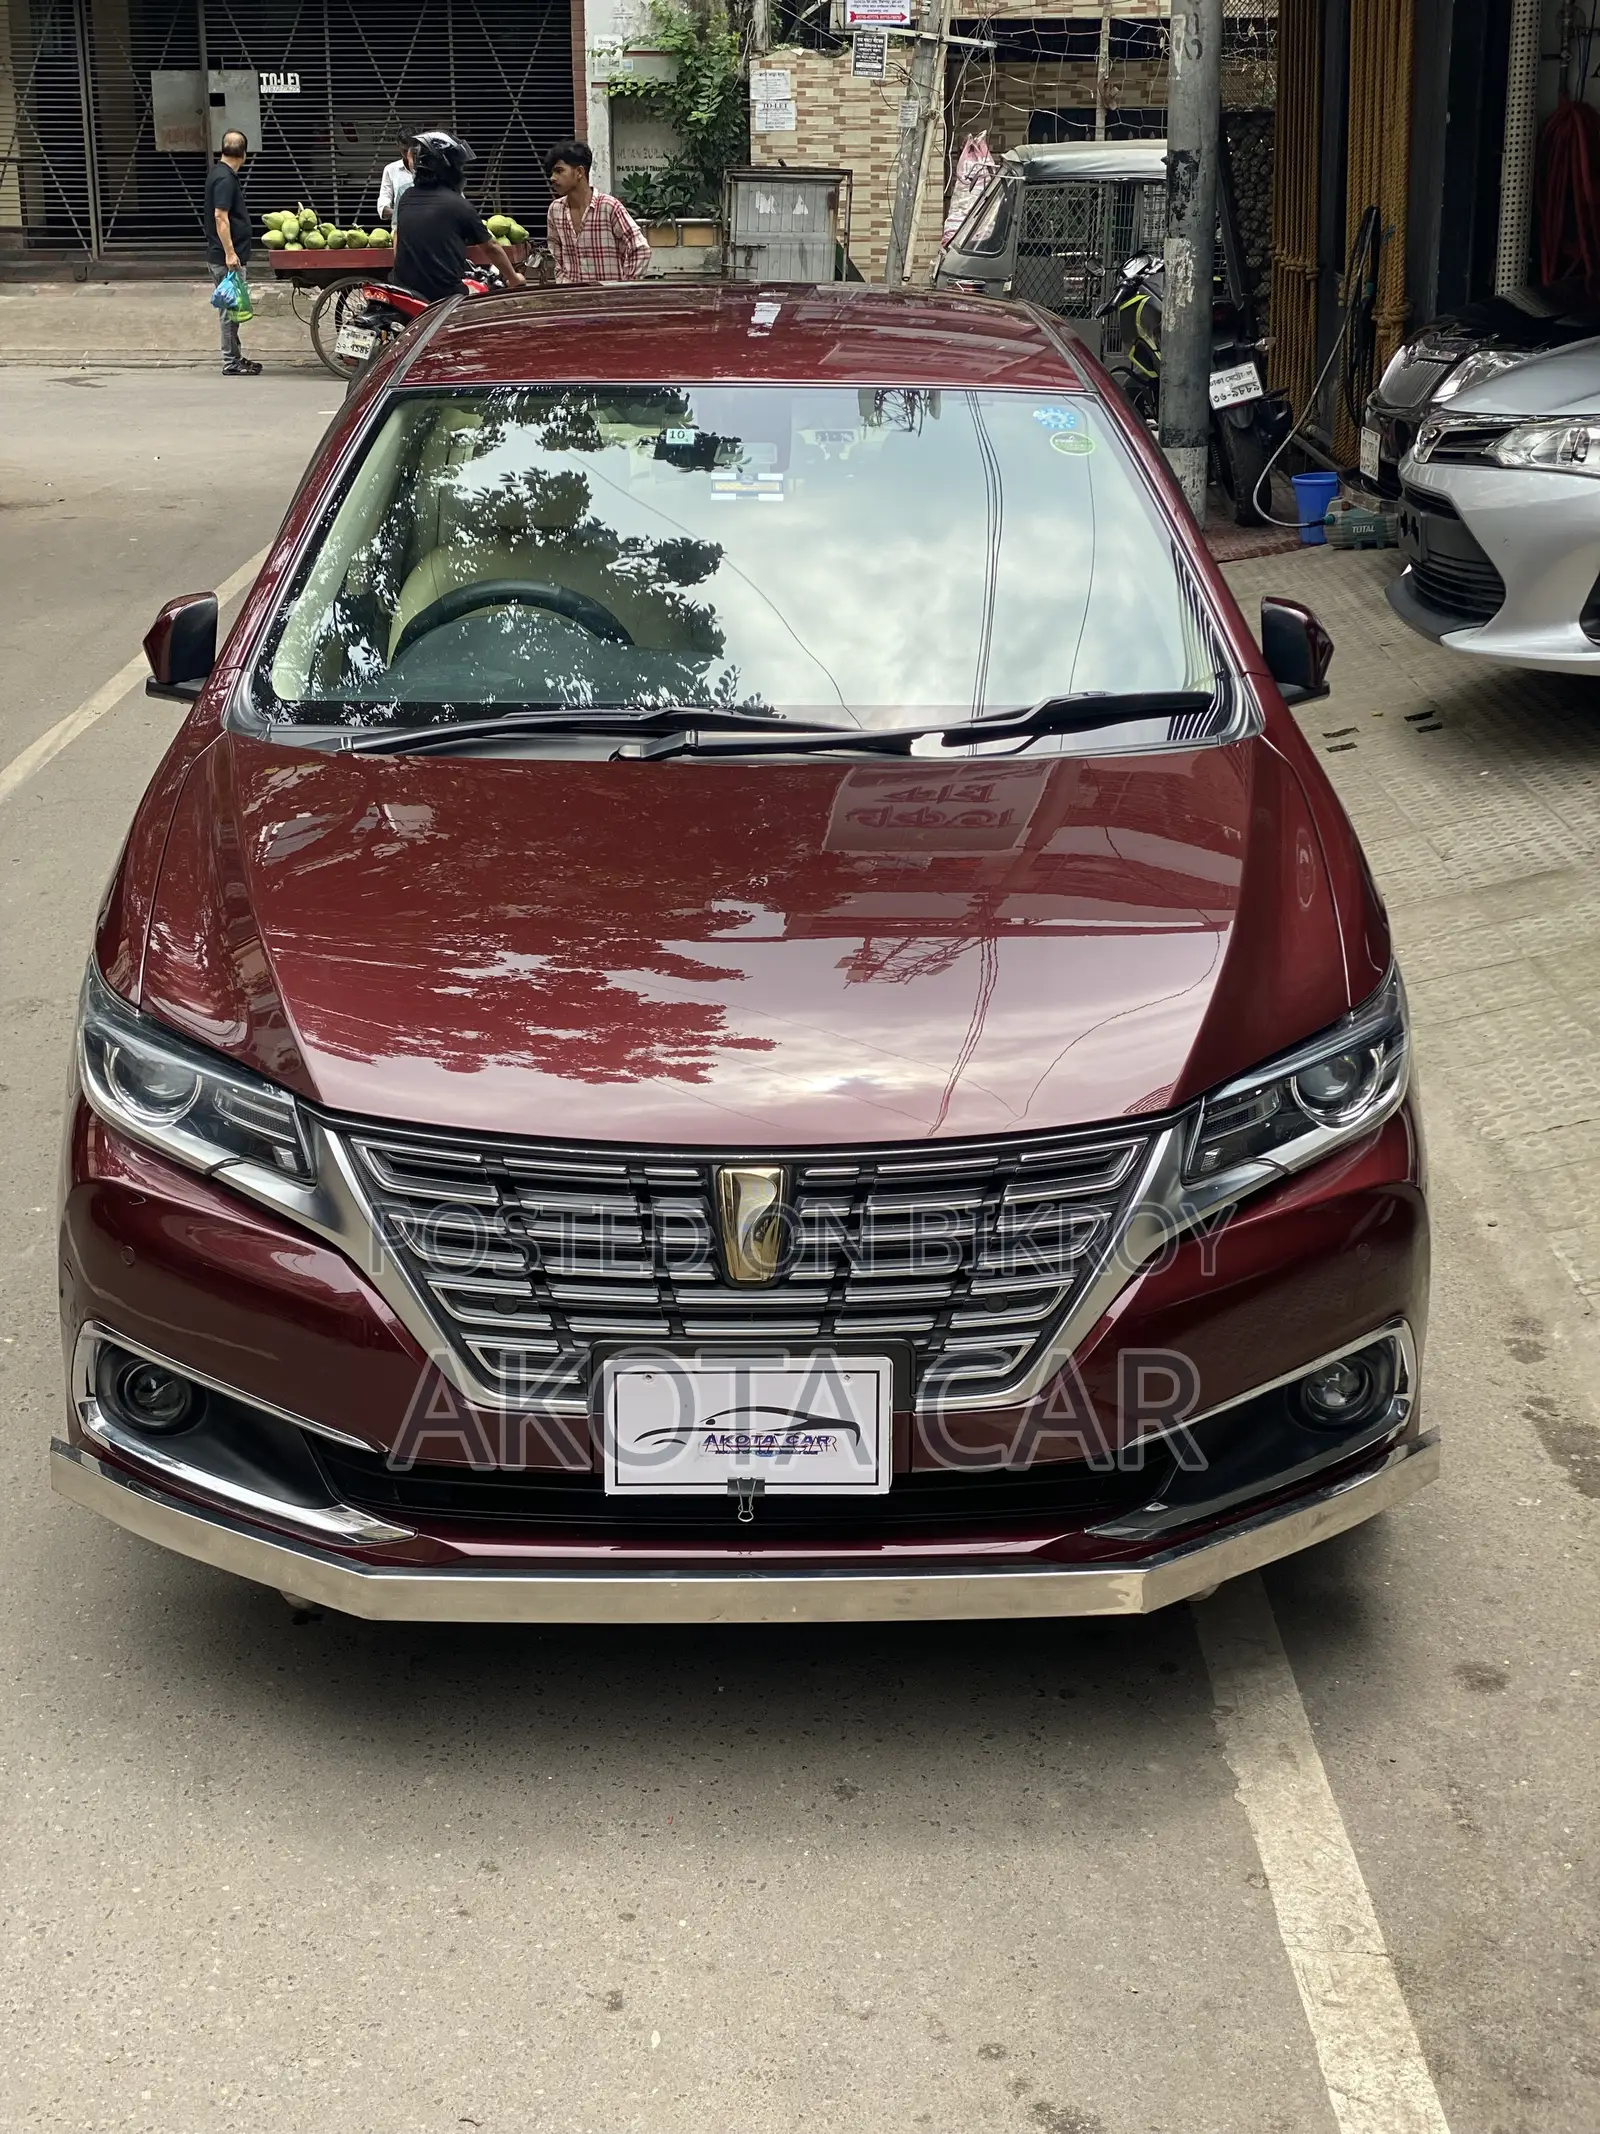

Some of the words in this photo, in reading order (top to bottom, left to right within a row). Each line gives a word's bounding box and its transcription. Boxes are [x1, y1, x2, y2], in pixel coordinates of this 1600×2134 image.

[669, 430, 685, 440] 10
[1352, 524, 1376, 534] TOTAL
[703, 1433, 778, 1447] AKOTA
[785, 1434, 829, 1447] CAR
